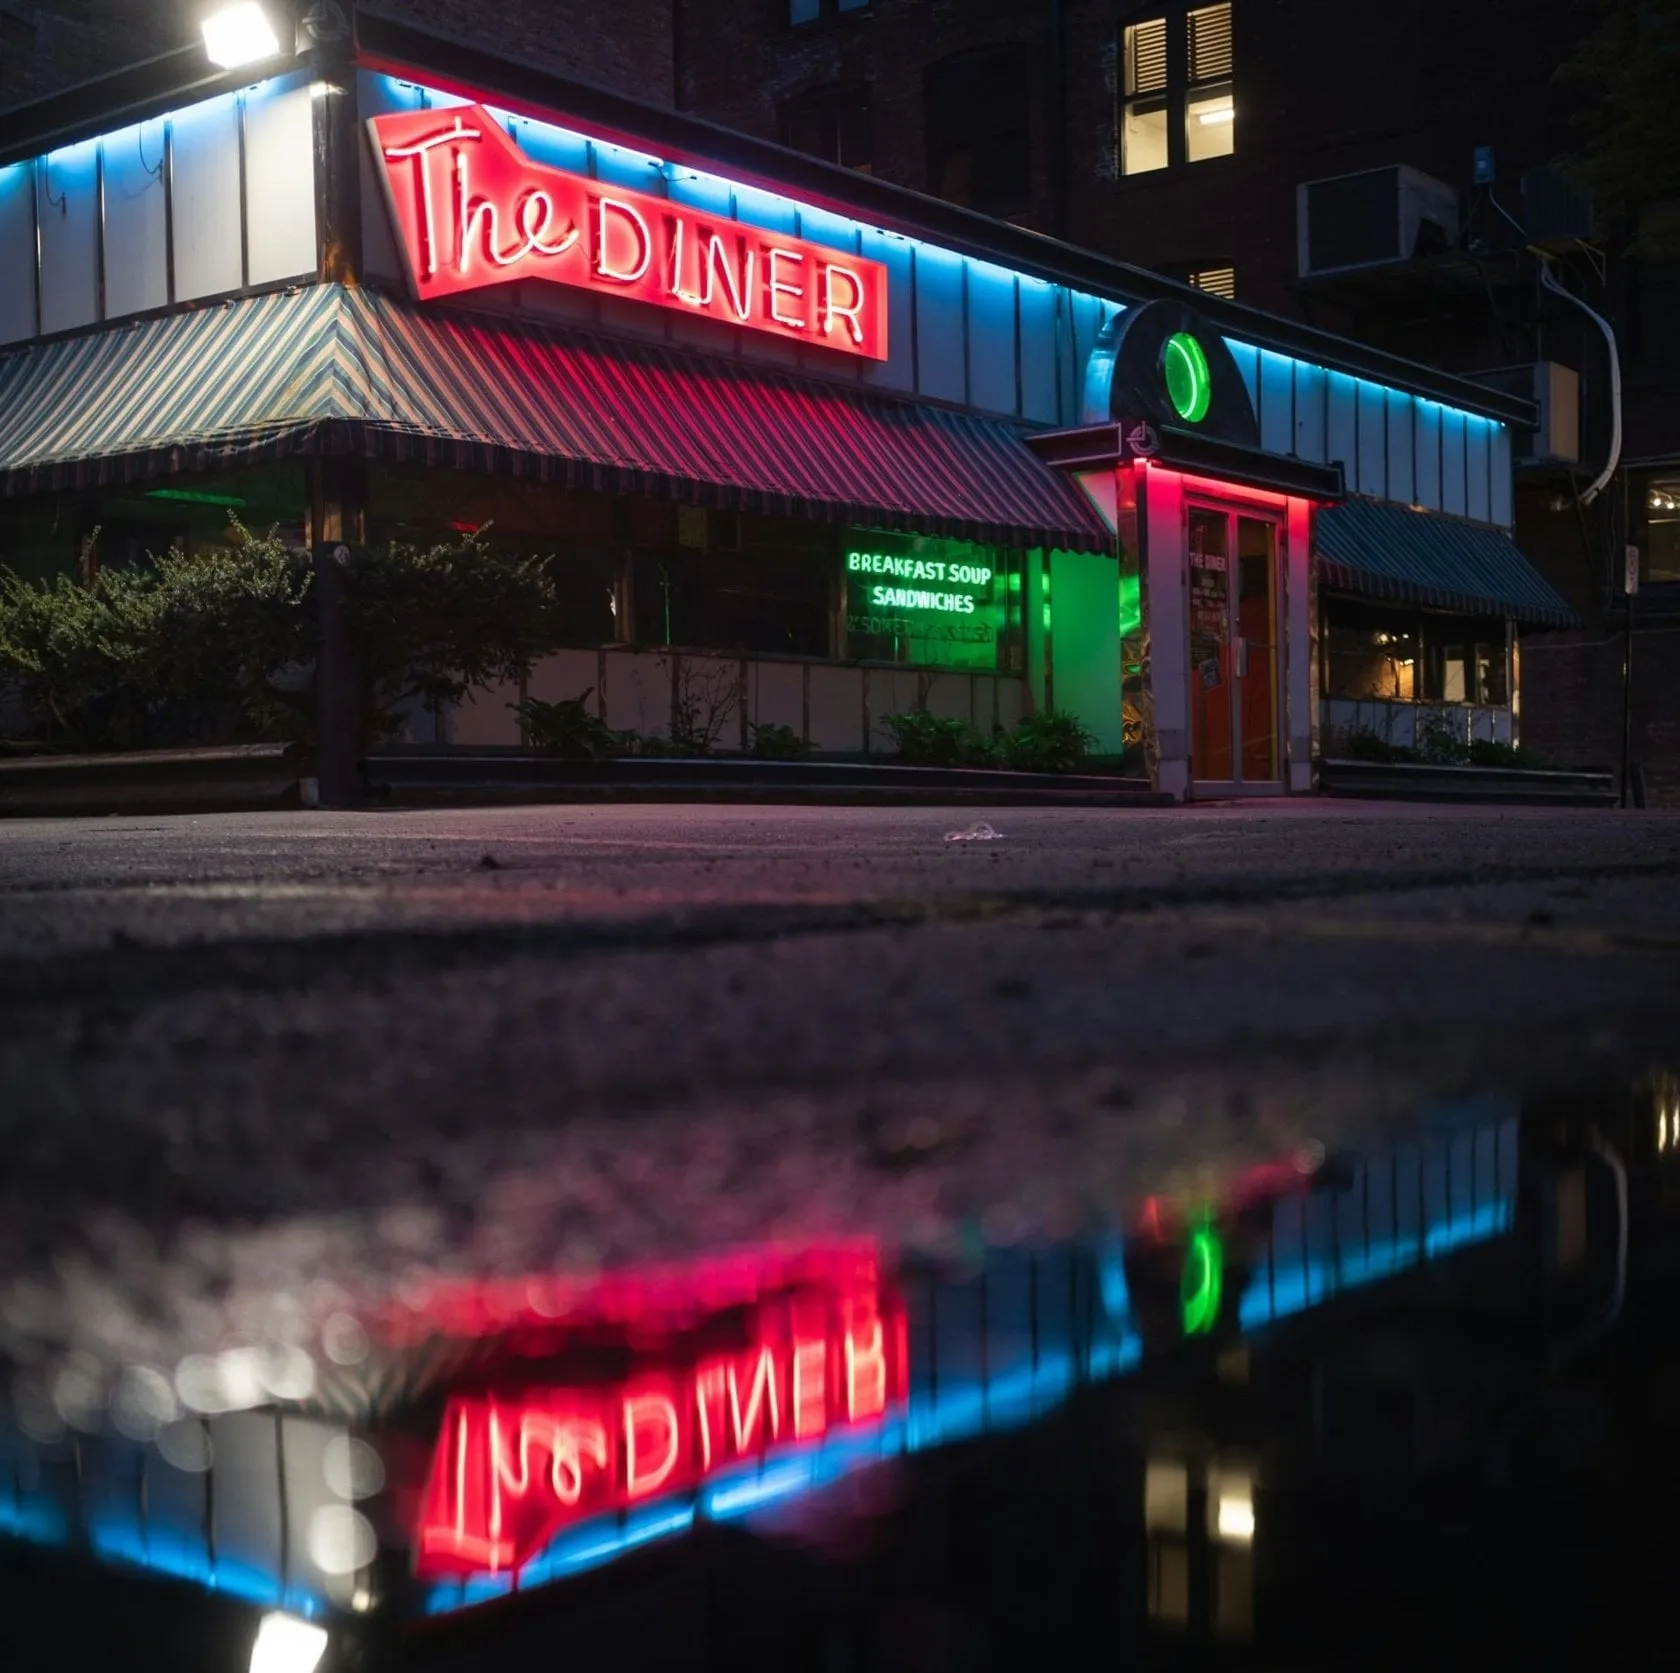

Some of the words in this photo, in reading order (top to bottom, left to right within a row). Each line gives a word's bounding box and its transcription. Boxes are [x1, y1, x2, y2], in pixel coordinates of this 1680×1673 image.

[386, 116, 579, 274] The
[599, 197, 864, 343] DINER
[848, 552, 946, 581] BREAKFAST
[948, 563, 992, 586] SOUP
[1189, 551, 1204, 568] THE
[872, 586, 975, 614] SANDWICHES
